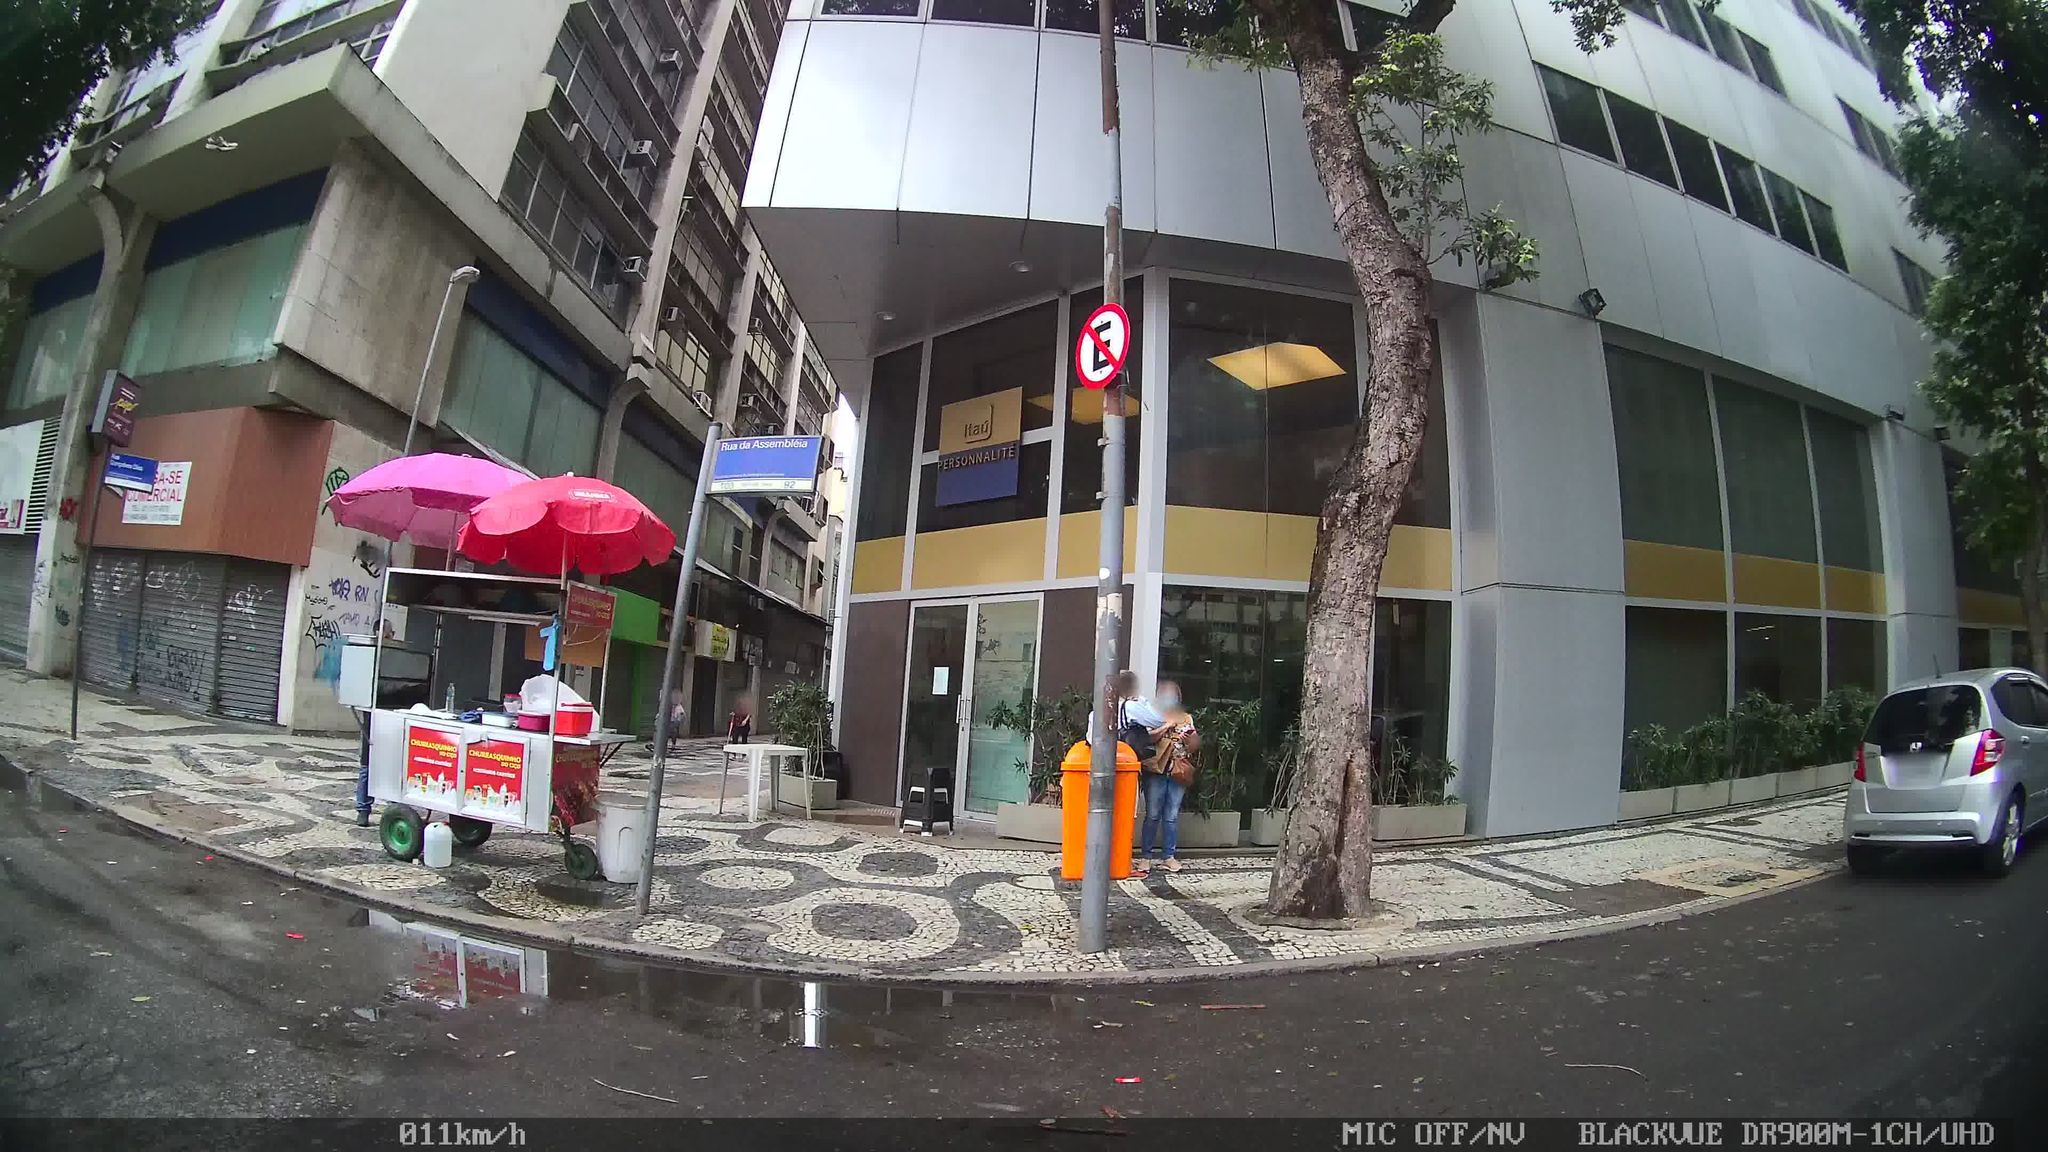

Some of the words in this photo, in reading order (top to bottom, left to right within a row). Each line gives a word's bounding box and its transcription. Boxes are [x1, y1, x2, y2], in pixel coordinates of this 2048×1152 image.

[964, 420, 990, 438] Itaú
[721, 442, 737, 451] Rua
[739, 441, 750, 450] da
[752, 438, 808, 449] Assembléia
[411, 739, 457, 753] CHURRASQUINHO
[468, 749, 521, 763] CHURRASQUINHO
